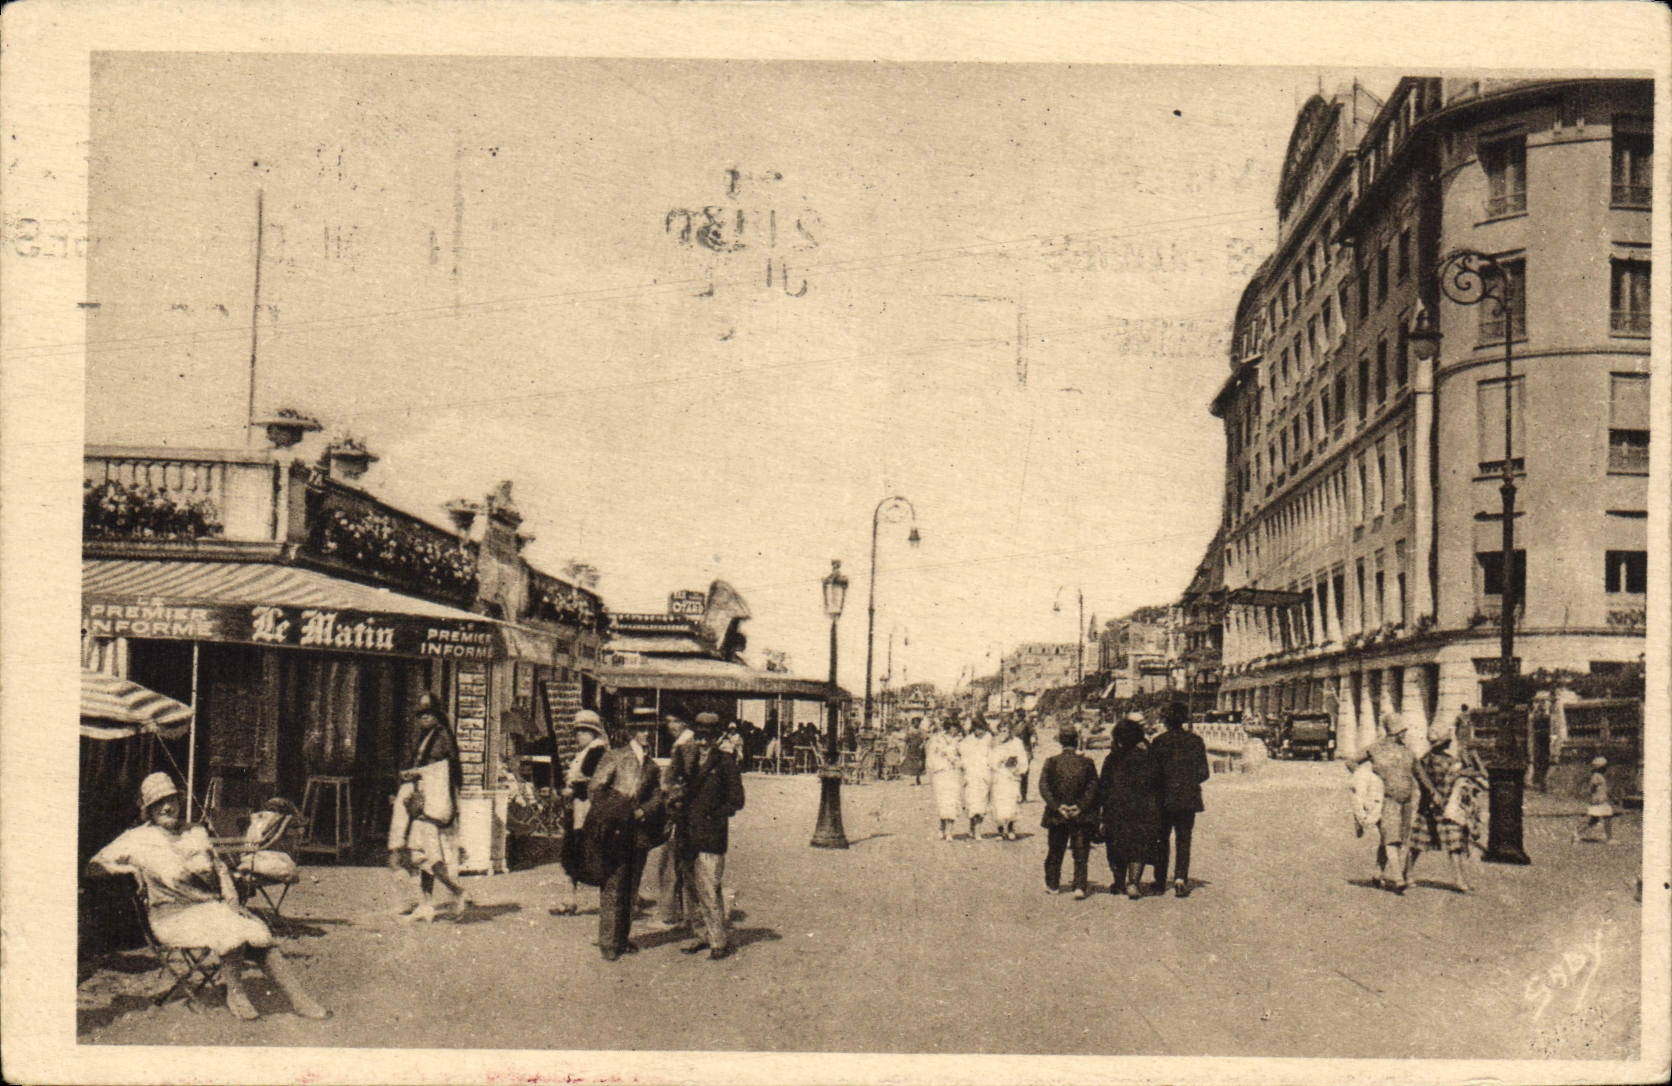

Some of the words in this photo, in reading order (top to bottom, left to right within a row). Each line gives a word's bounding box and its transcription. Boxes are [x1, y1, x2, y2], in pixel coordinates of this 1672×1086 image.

[90, 604, 208, 621] PREMIER
[251, 605, 291, 643] Le
[300, 609, 395, 650] Matin
